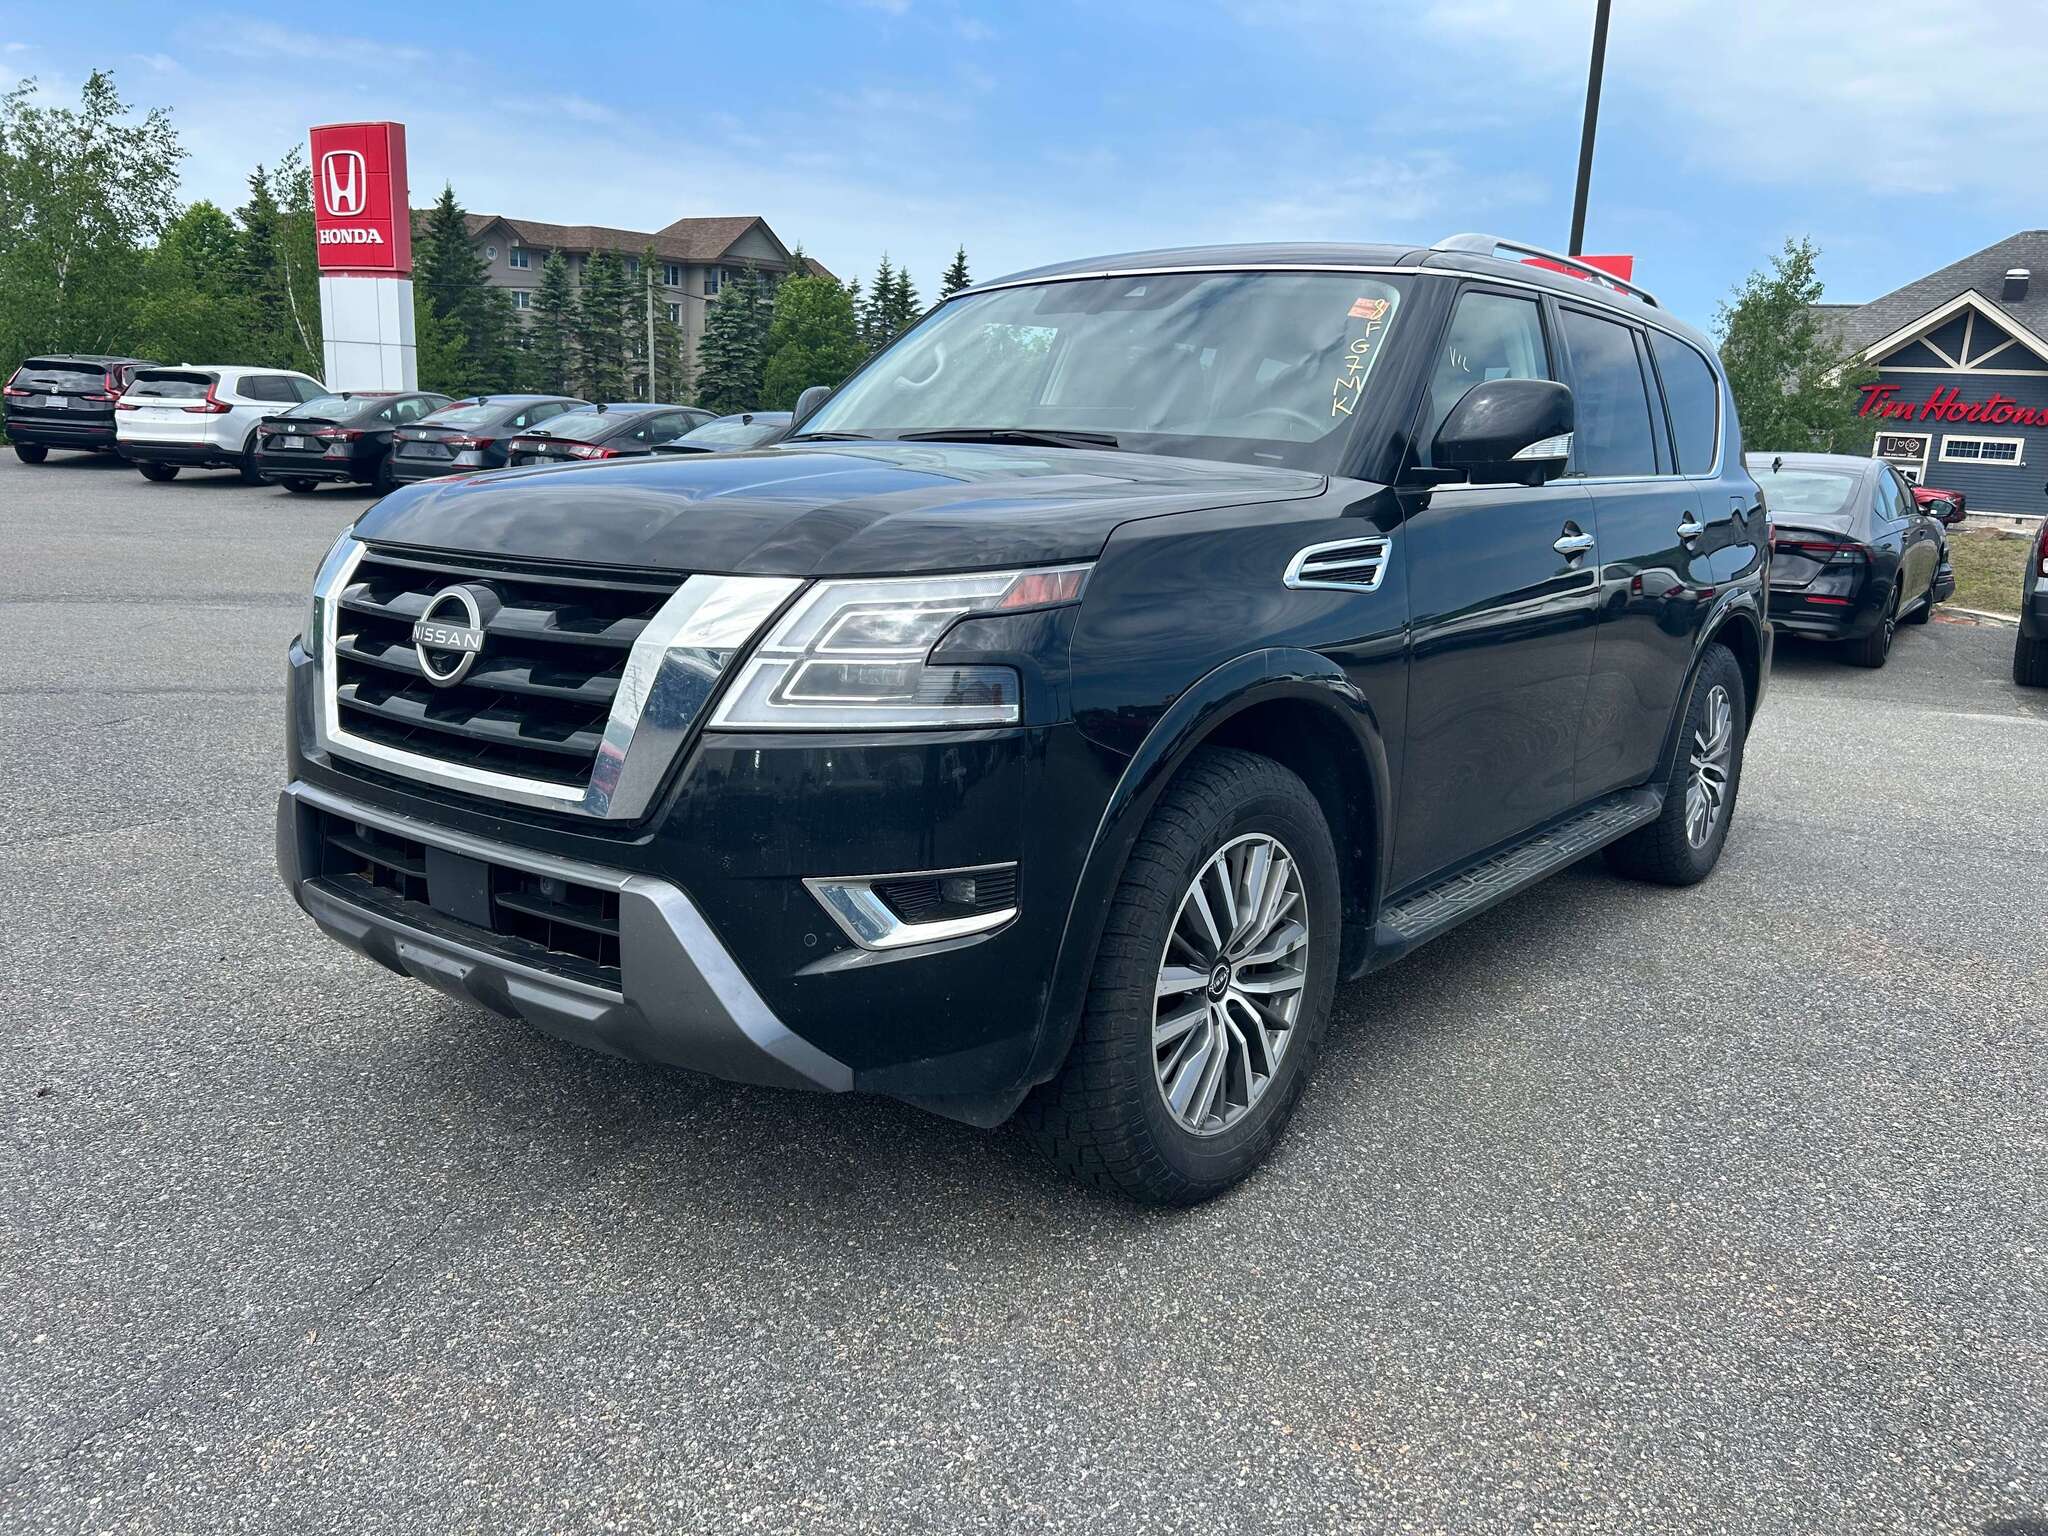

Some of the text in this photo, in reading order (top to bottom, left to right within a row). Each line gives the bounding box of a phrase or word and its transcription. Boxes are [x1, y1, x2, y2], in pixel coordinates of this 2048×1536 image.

[319, 228, 385, 245] HONDA
[1919, 383, 2048, 427] Hortons
[412, 624, 481, 649] NISSAN
